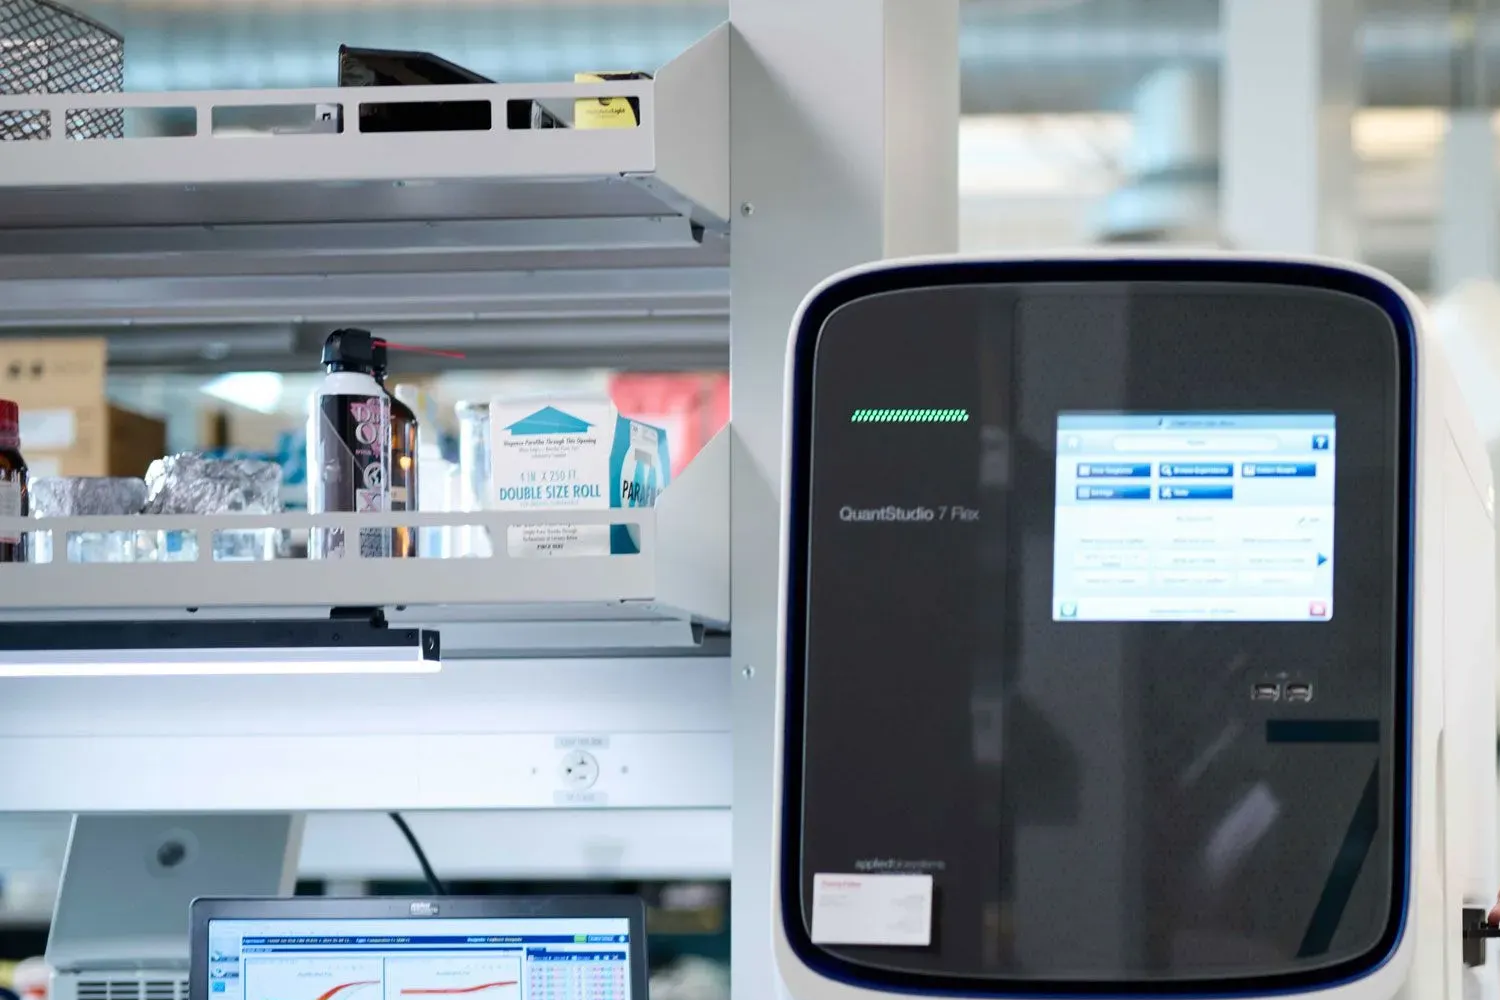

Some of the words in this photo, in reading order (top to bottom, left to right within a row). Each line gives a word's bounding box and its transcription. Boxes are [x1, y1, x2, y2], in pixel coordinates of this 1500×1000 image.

[549, 469, 566, 481] 250
[500, 485, 542, 500] DOUBLE
[546, 484, 570, 499] SIZE
[573, 484, 601, 498] ROLL
[839, 505, 934, 521] QuantStudio
[938, 505, 948, 520] 7
[951, 505, 980, 520] Flex
